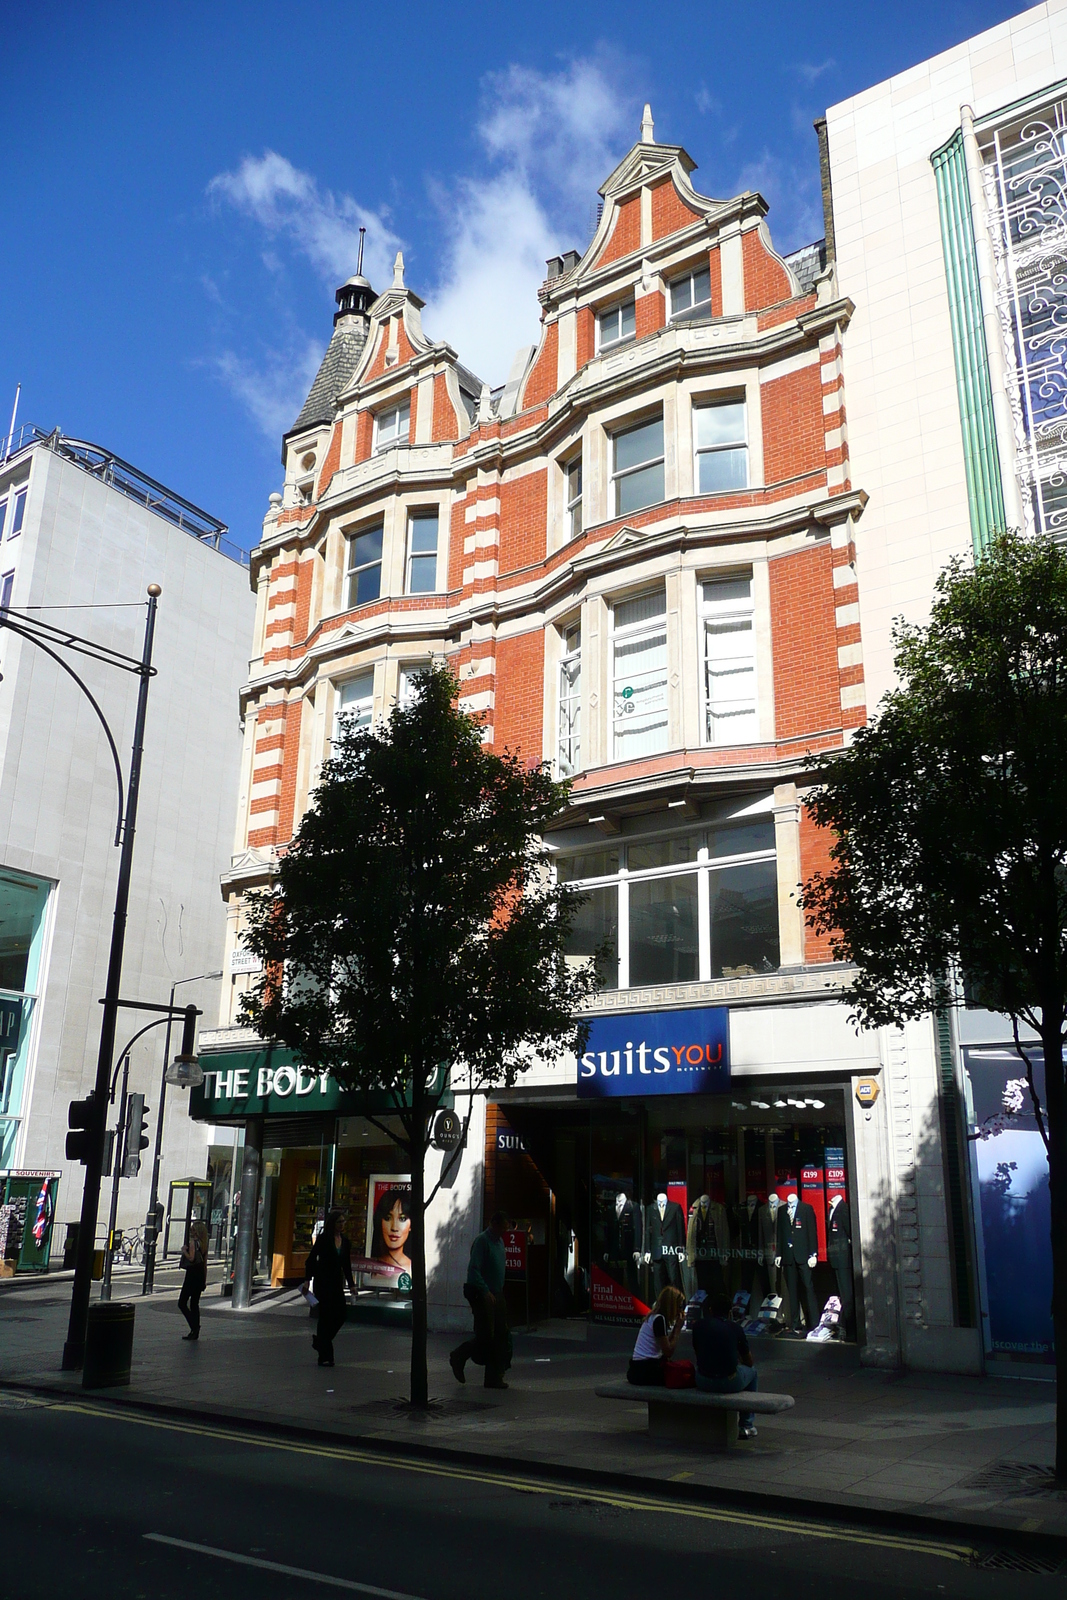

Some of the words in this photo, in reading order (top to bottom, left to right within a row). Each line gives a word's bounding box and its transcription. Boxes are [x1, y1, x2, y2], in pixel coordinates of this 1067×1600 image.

[232, 950, 253, 958] OXFOR
[231, 957, 251, 966] STREET
[580, 1041, 671, 1077] suits
[671, 1043, 722, 1066] YOU
[203, 1068, 250, 1099] THE
[256, 1065, 331, 1097] BODY
[15, 1169, 56, 1178] SOUVENIRS
[803, 1170, 818, 1178] £199
[828, 1170, 844, 1178] £109
[377, 1183, 390, 1191] THE
[390, 1183, 407, 1191] BODY
[509, 1233, 516, 1244] 2
[504, 1245, 522, 1253] suits
[710, 1247, 764, 1259] BUSINESS
[505, 1258, 522, 1268] £130
[592, 1283, 614, 1294] Final
[592, 1294, 633, 1304] CLEARANCE
[992, 1338, 1029, 1351] iscover
